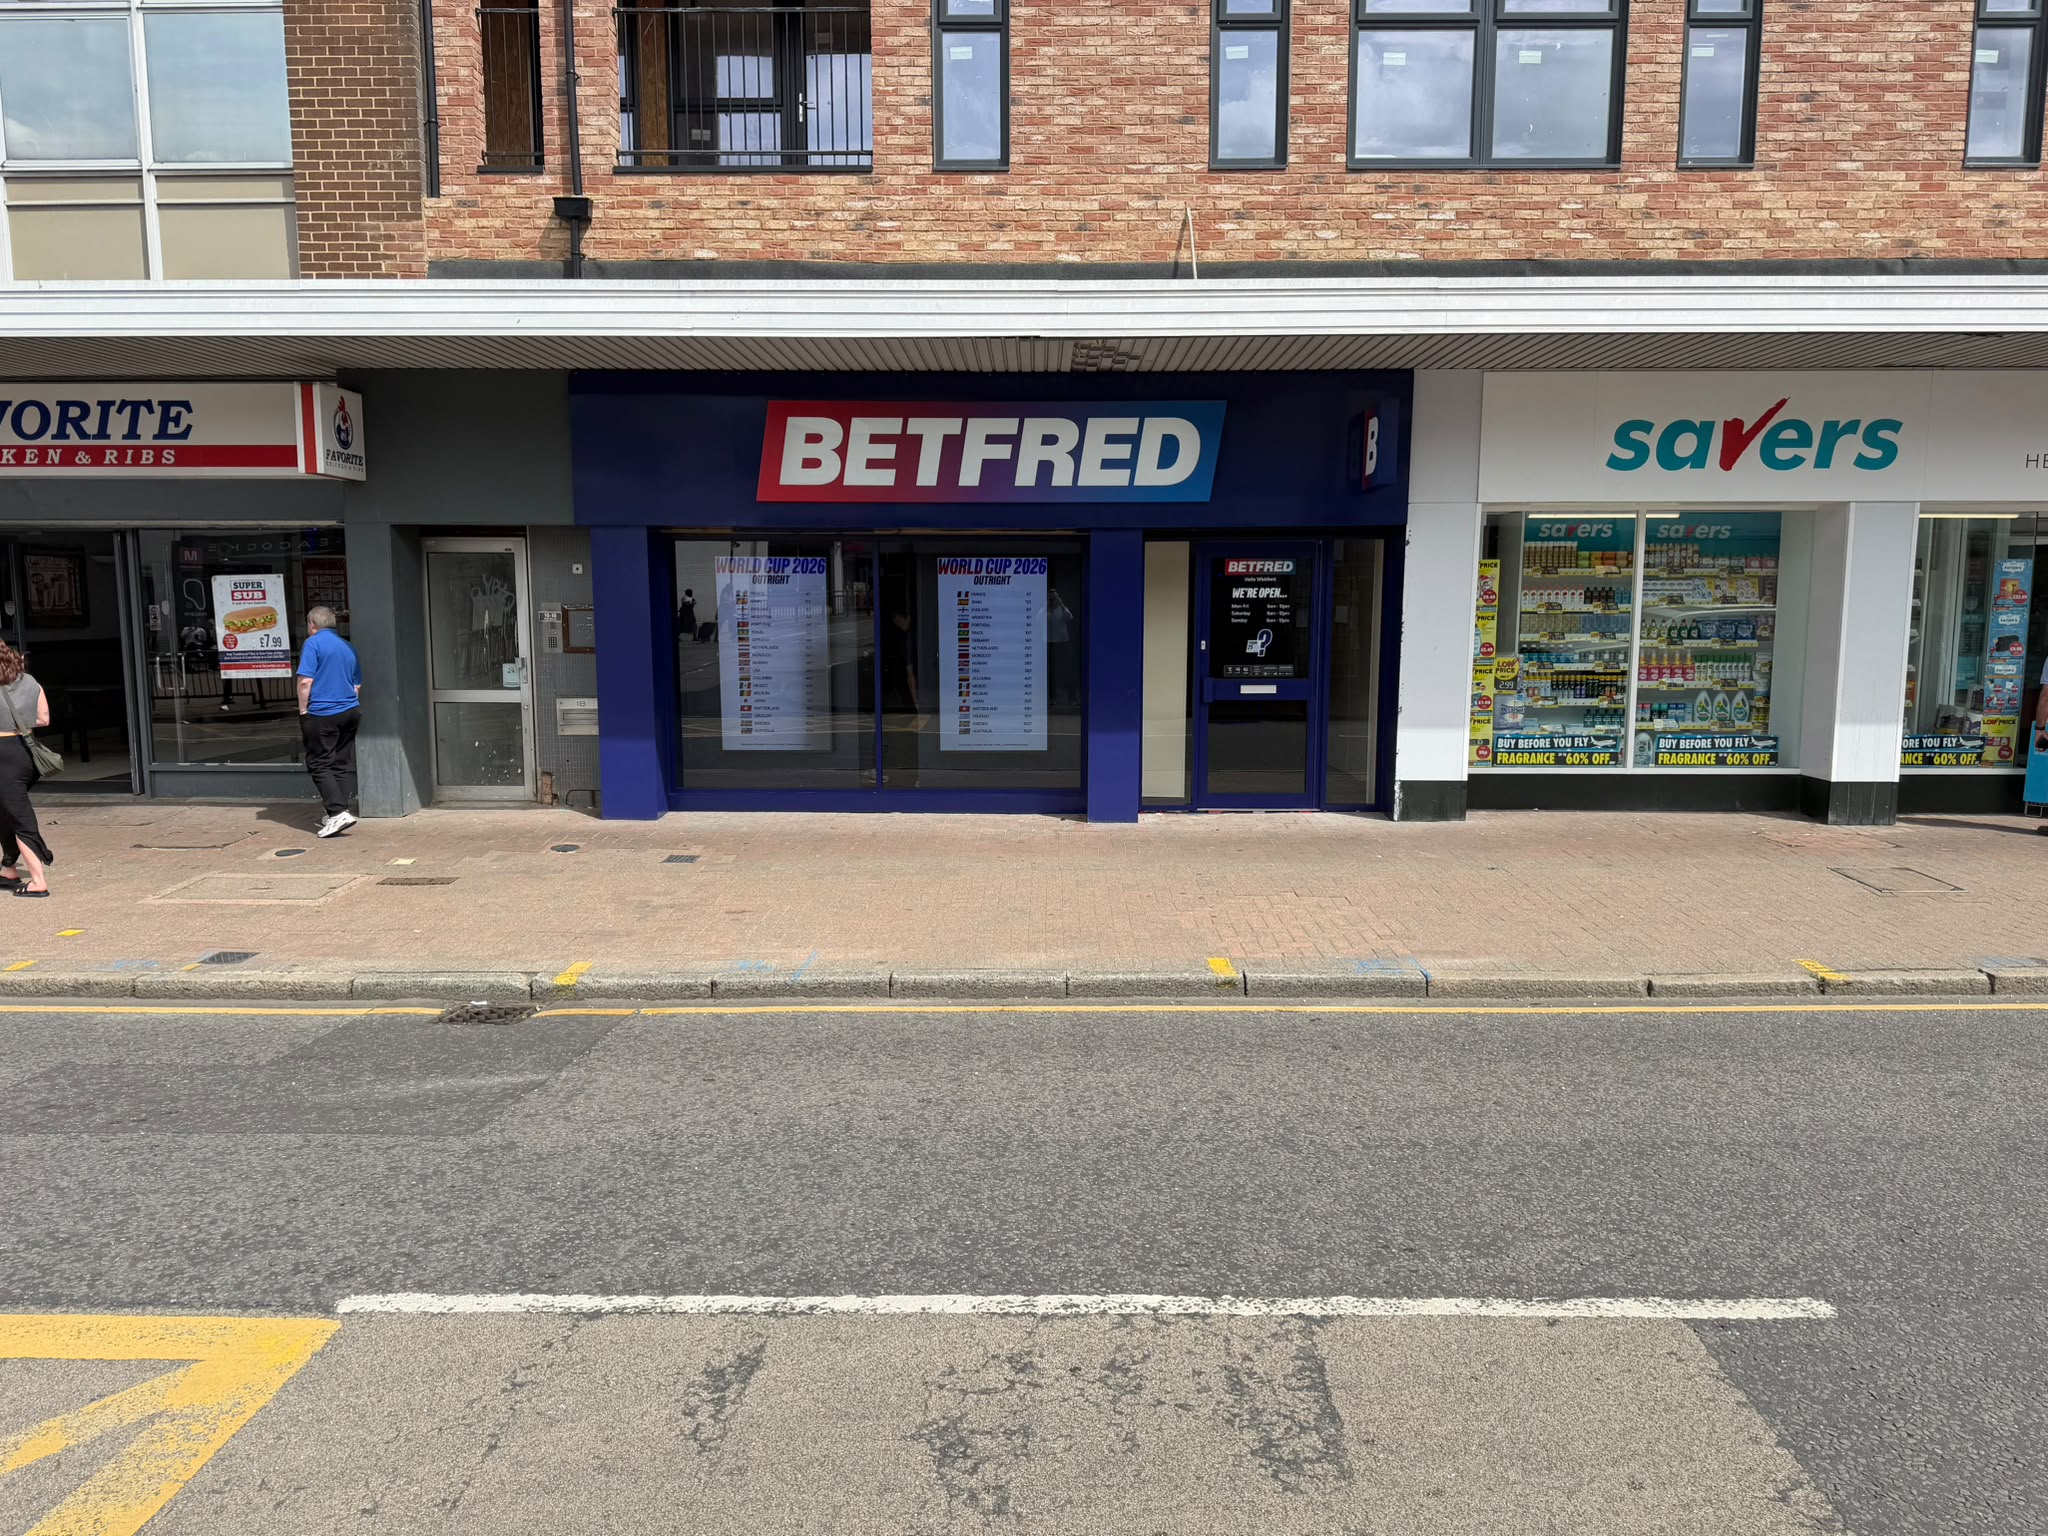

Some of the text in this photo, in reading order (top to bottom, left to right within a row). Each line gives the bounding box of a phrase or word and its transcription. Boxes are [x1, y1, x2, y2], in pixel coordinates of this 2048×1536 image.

[1606, 397, 1903, 471] savers
[779, 416, 1201, 486] BETFRED
[1365, 416, 1378, 476] B
[75, 451, 92, 464] &
[104, 449, 176, 464] RIBS
[326, 449, 364, 467] FAVORITE
[1539, 520, 1613, 537] savers
[1657, 523, 1732, 539] savers
[716, 558, 826, 574] WORLD CUP 2026
[938, 558, 1047, 575] WORLD CUP 2026
[1228, 561, 1294, 573] BETFRED
[233, 581, 263, 589] SUPER
[752, 575, 791, 585] OUTRIGHT
[973, 575, 1012, 586] OUTRIGHT
[233, 591, 263, 600] SUB
[1232, 587, 1258, 599] WE'RE
[260, 633, 282, 648] £7.99
[1497, 658, 1519, 668] LOW
[1499, 681, 1514, 689] 2.99
[1998, 718, 2016, 726] PRICE
[1498, 738, 1516, 749] BUY
[1517, 738, 1550, 749] BEFORE
[1553, 738, 1572, 748] YOU
[1574, 737, 1589, 747] FLY
[1659, 737, 1749, 749] BUY BEFORE YOU FLY
[1922, 738, 1939, 748] YOU
[1943, 737, 1957, 747] FLY
[1497, 752, 1610, 765] FRAGRANCE 60% OFF
[1658, 752, 1770, 765] FRAGRANCE 60% OFF
[1933, 753, 1957, 765] 60%
[1960, 753, 1977, 765] OFF
